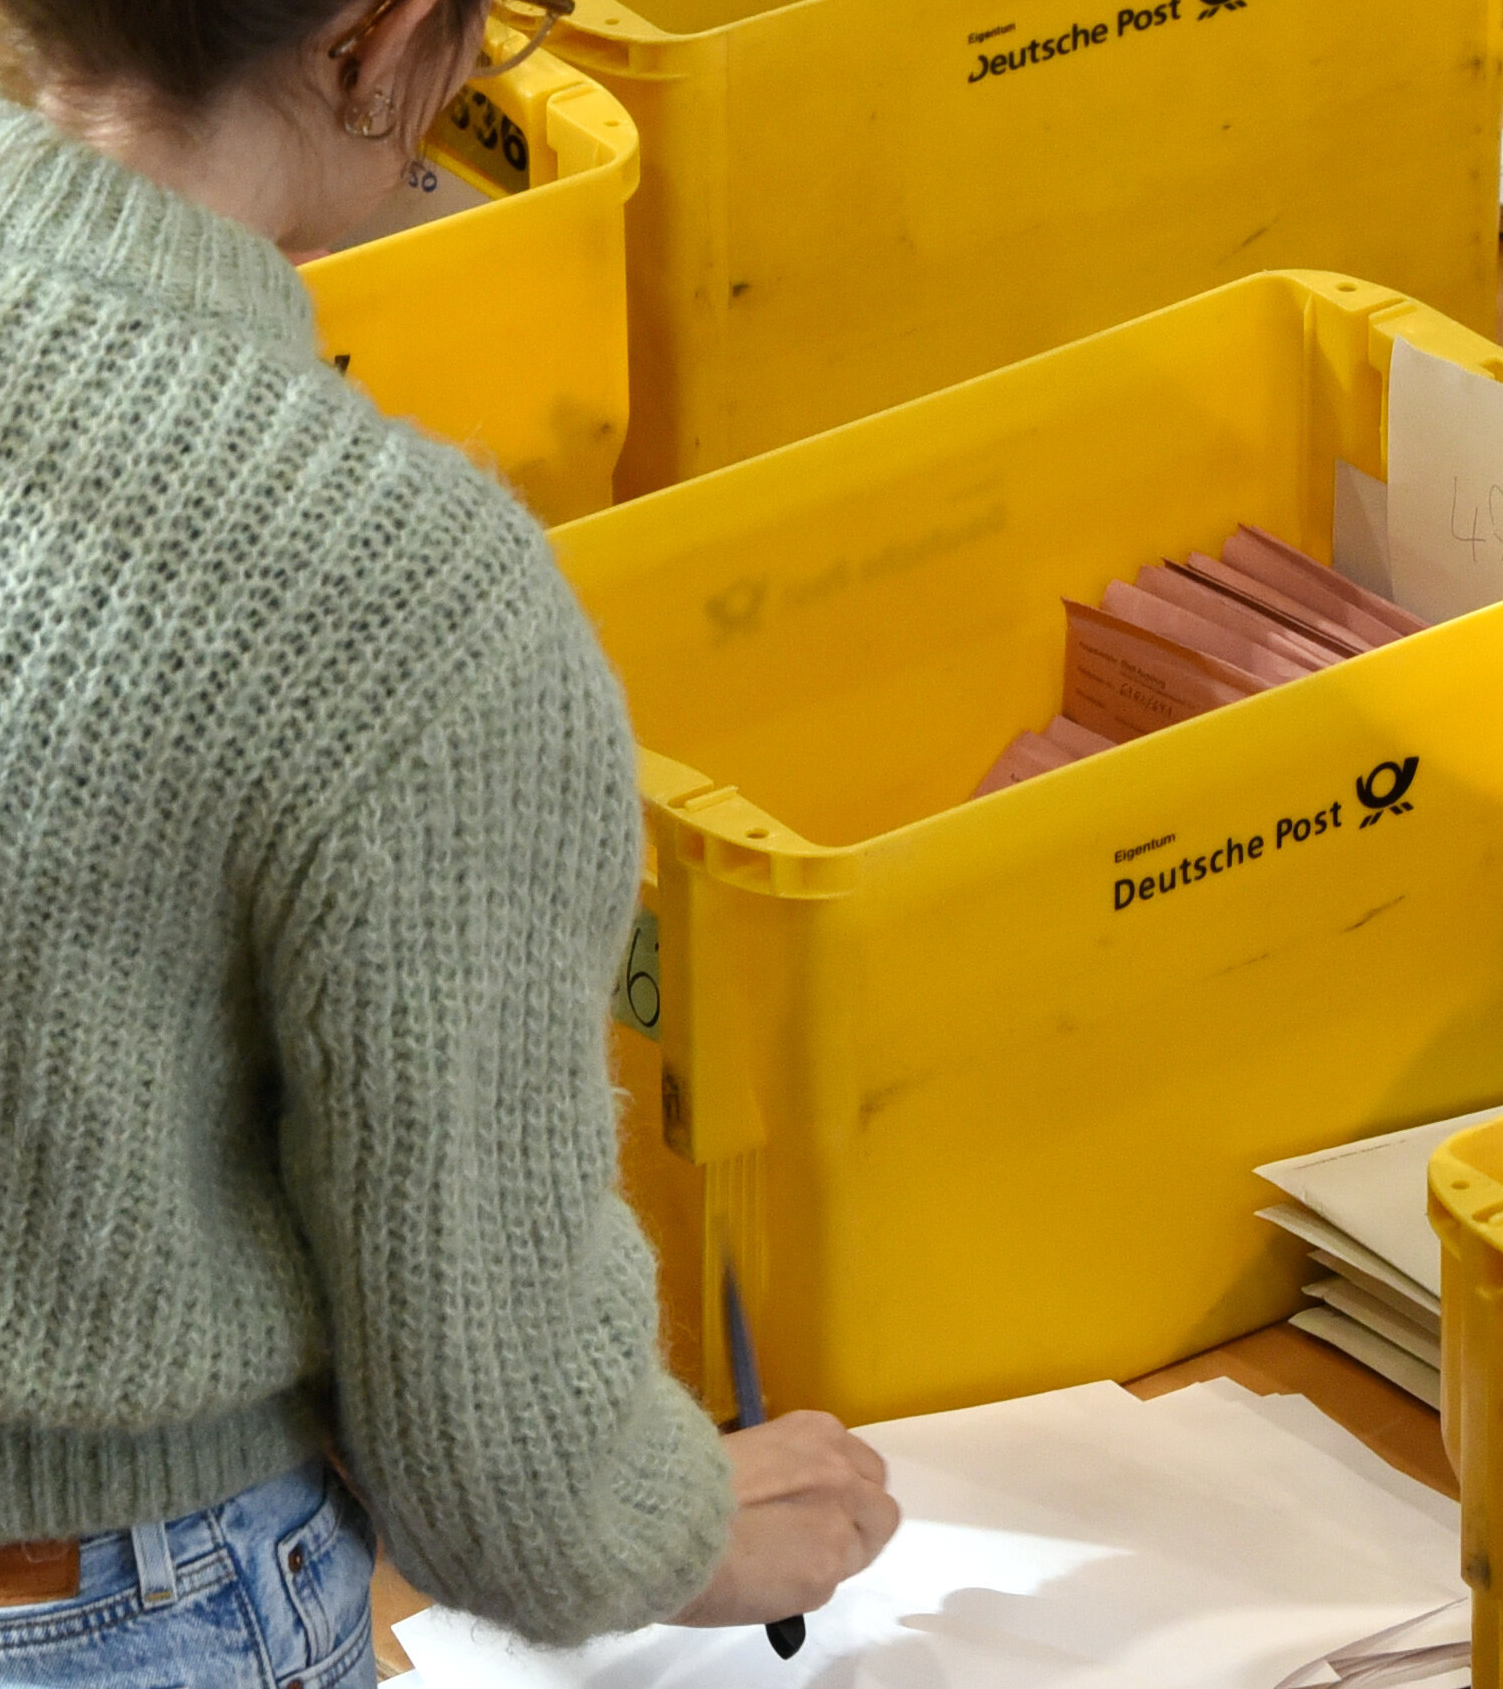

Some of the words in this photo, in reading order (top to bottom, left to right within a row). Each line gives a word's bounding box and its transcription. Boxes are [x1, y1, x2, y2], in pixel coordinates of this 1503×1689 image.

[967, 22, 1016, 45] Eigentum
[1113, 836, 1264, 911] Deutsche
[1276, 801, 1342, 850] Post
[1114, 832, 1176, 864] Eigentum
